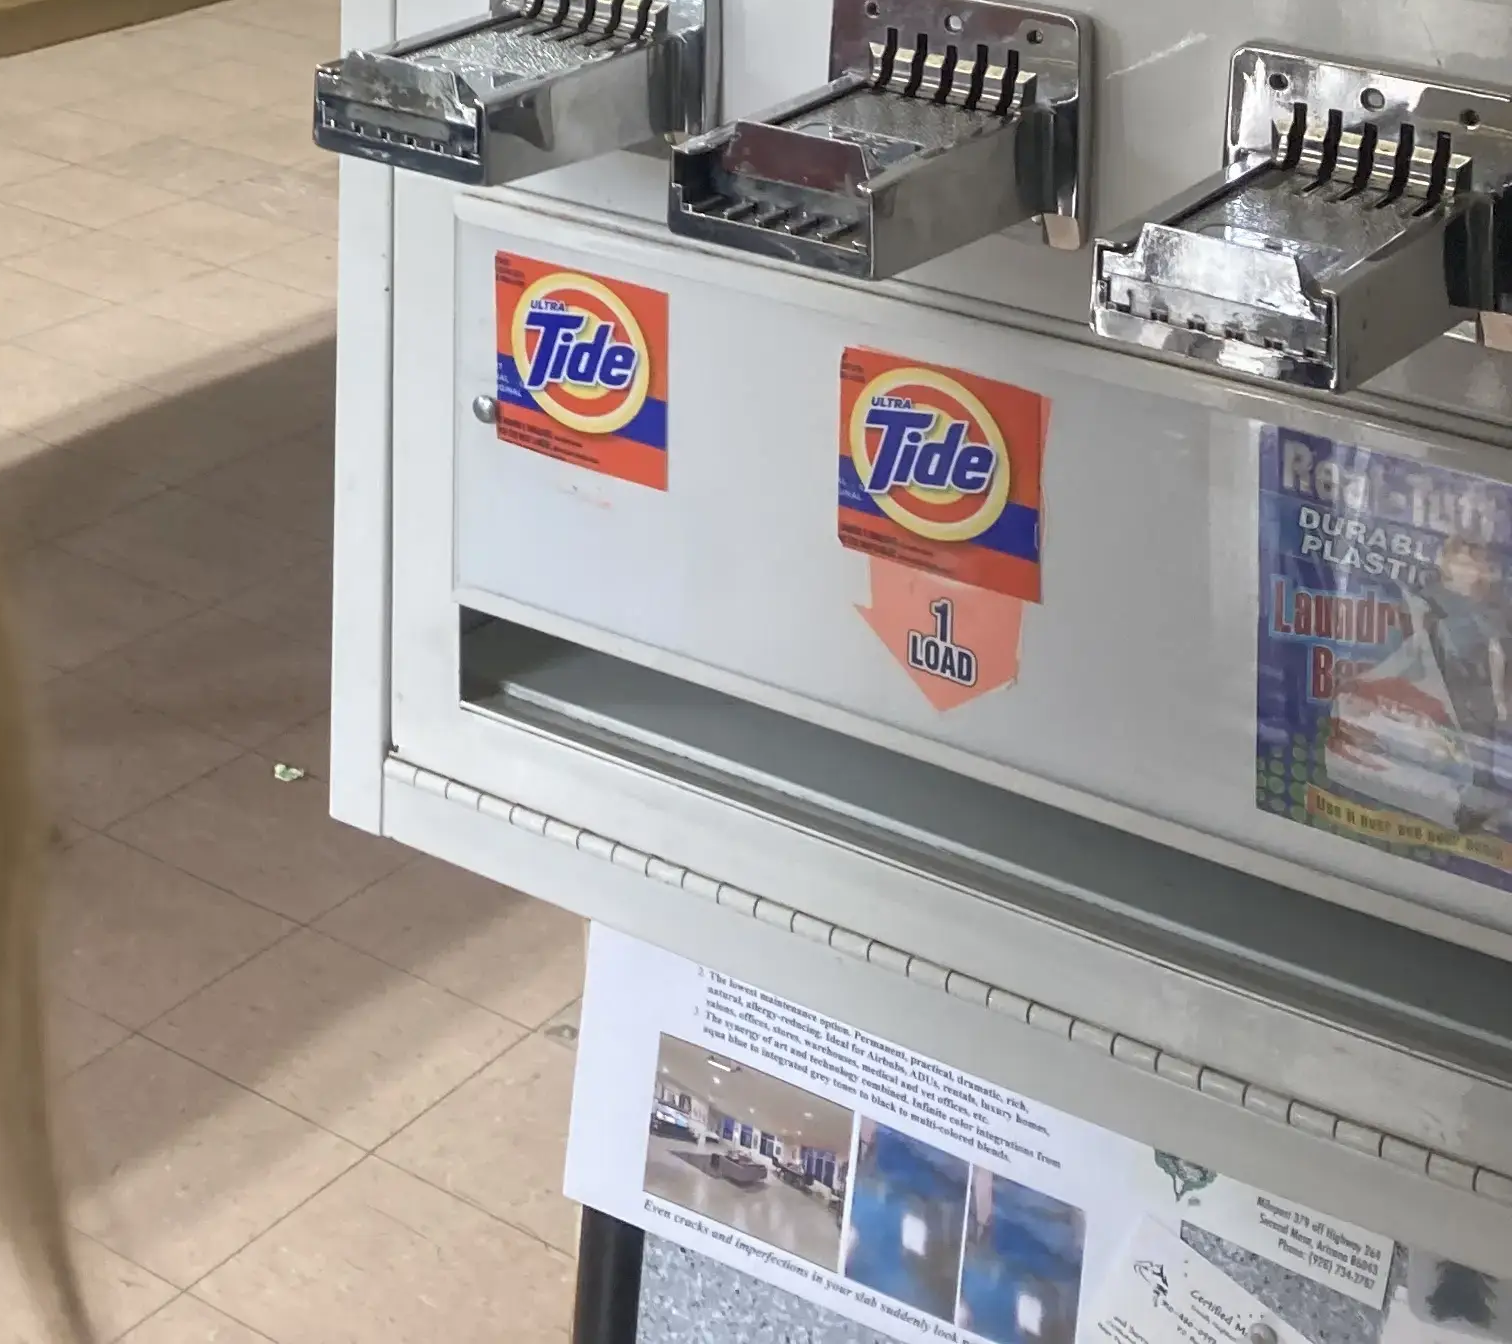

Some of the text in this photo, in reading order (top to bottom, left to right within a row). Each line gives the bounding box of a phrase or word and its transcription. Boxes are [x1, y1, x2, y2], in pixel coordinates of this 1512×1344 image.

[530, 300, 566, 311] ULTRA
[526, 312, 636, 389] Tide
[871, 396, 912, 410] ULTRA
[867, 409, 994, 492] Tide
[910, 635, 974, 683] LOAD
[933, 602, 950, 642] 1
[708, 987, 743, 1007] natural,
[826, 1032, 849, 1049] Ideal
[852, 1044, 865, 1056] for
[943, 1085, 978, 1107] rentals,
[981, 1099, 1012, 1123] luxury
[1015, 1113, 1050, 1137] homes,
[709, 971, 726, 985] The
[729, 978, 757, 997] lowest
[760, 992, 817, 1022] maintenance
[854, 1031, 908, 1061] Permanent,
[910, 1056, 954, 1083] practical,
[957, 1075, 1003, 1103] dramatic,
[1006, 1098, 1029, 1114] rich,
[772, 1025, 802, 1044] stores,
[804, 1039, 859, 1069] warehouses,
[862, 1063, 898, 1085] medical
[901, 1081, 918, 1093] and
[921, 1088, 935, 1101] vet
[703, 1026, 725, 1042] aqua
[728, 1032, 747, 1049] blue
[750, 1043, 759, 1053] to
[762, 1047, 808, 1074] integrated
[810, 1069, 830, 1086] grey
[833, 1078, 857, 1095] tones
[859, 1090, 869, 1100] to
[871, 1094, 896, 1113] black
[899, 1107, 908, 1117] to
[910, 1113, 975, 1147] multi-colored
[706, 1011, 722, 1025] The
[725, 1020, 759, 1041] synergy
[762, 1036, 773, 1045] of
[774, 1040, 787, 1052] art
[790, 1048, 807, 1060] and
[810, 1054, 859, 1083] technology
[912, 1098, 947, 1121] Infinite
[949, 1116, 975, 1132] color
[976, 1126, 1034, 1158] integrations
[1037, 1150, 1061, 1169] from
[643, 1199, 958, 1344] Even cracks and imperfections in your slab suddenly look
[1190, 1289, 1233, 1326] Certified
